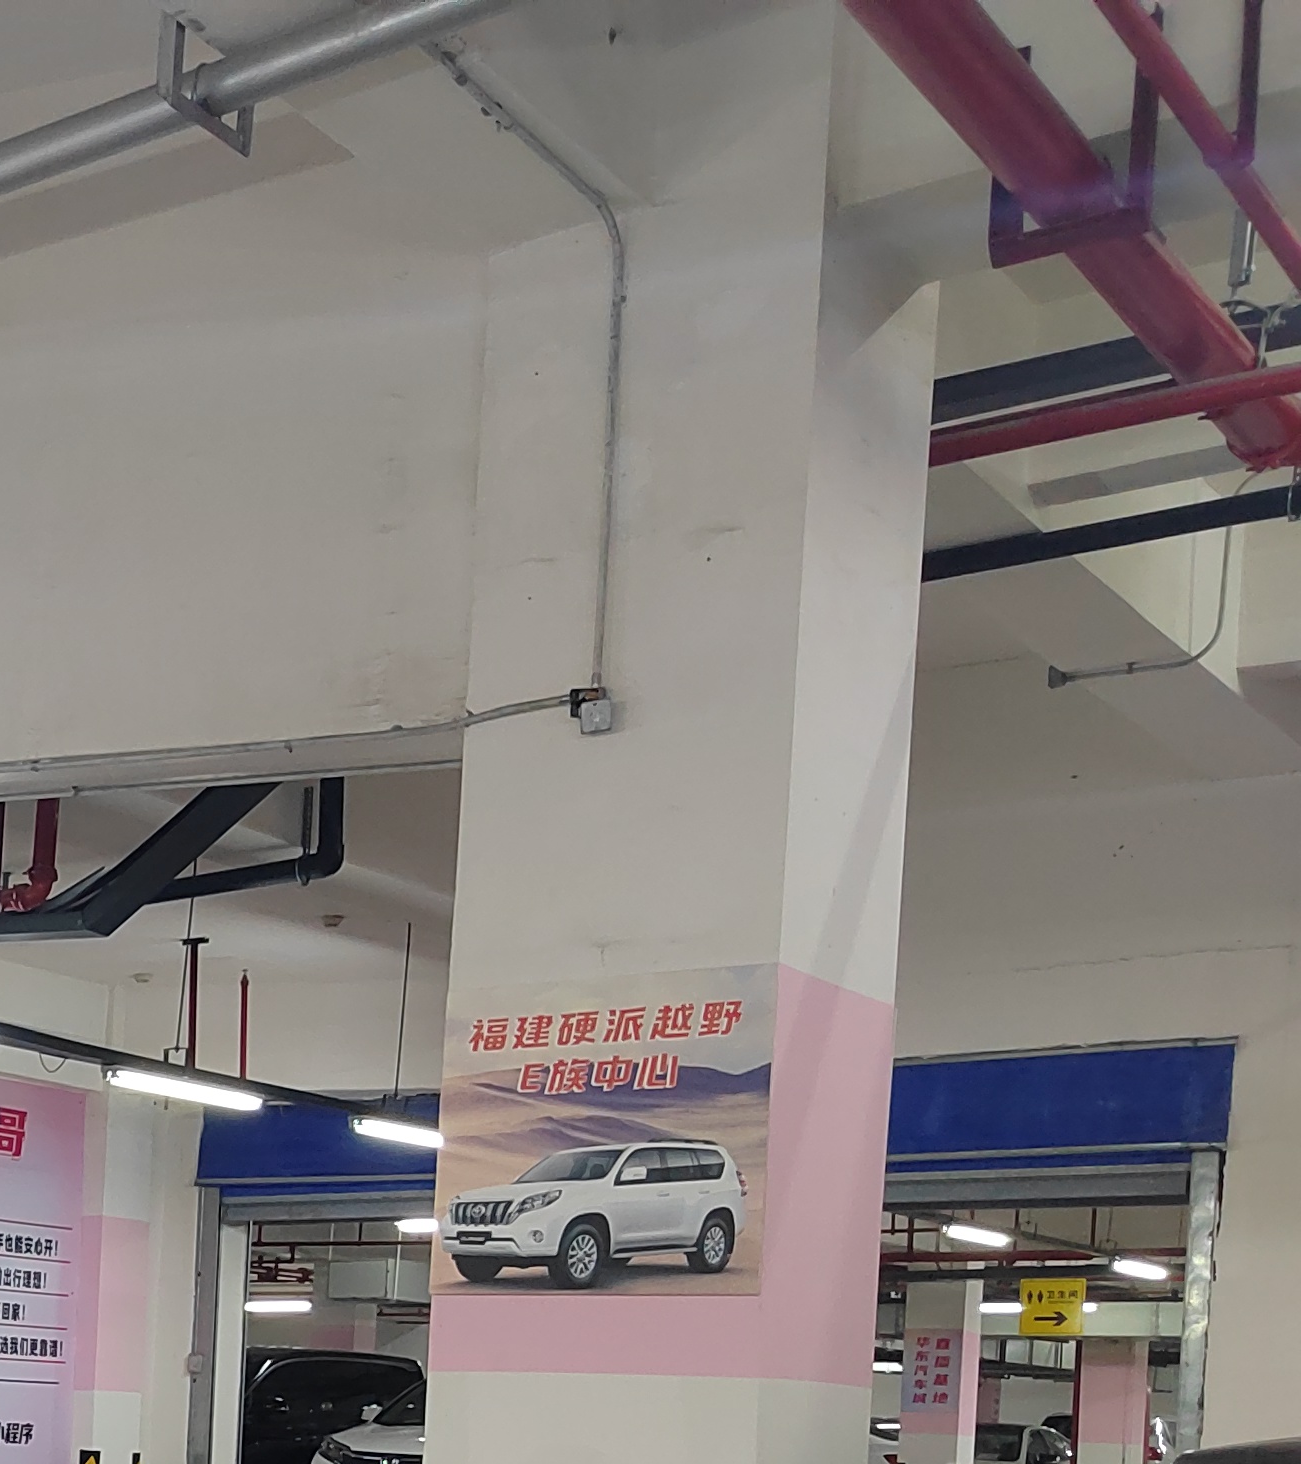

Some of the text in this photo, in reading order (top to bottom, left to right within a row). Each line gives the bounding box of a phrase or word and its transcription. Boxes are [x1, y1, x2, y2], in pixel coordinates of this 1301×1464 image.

[468, 1000, 743, 1052] 福建硬派越野
[517, 1053, 679, 1095] E族中心
